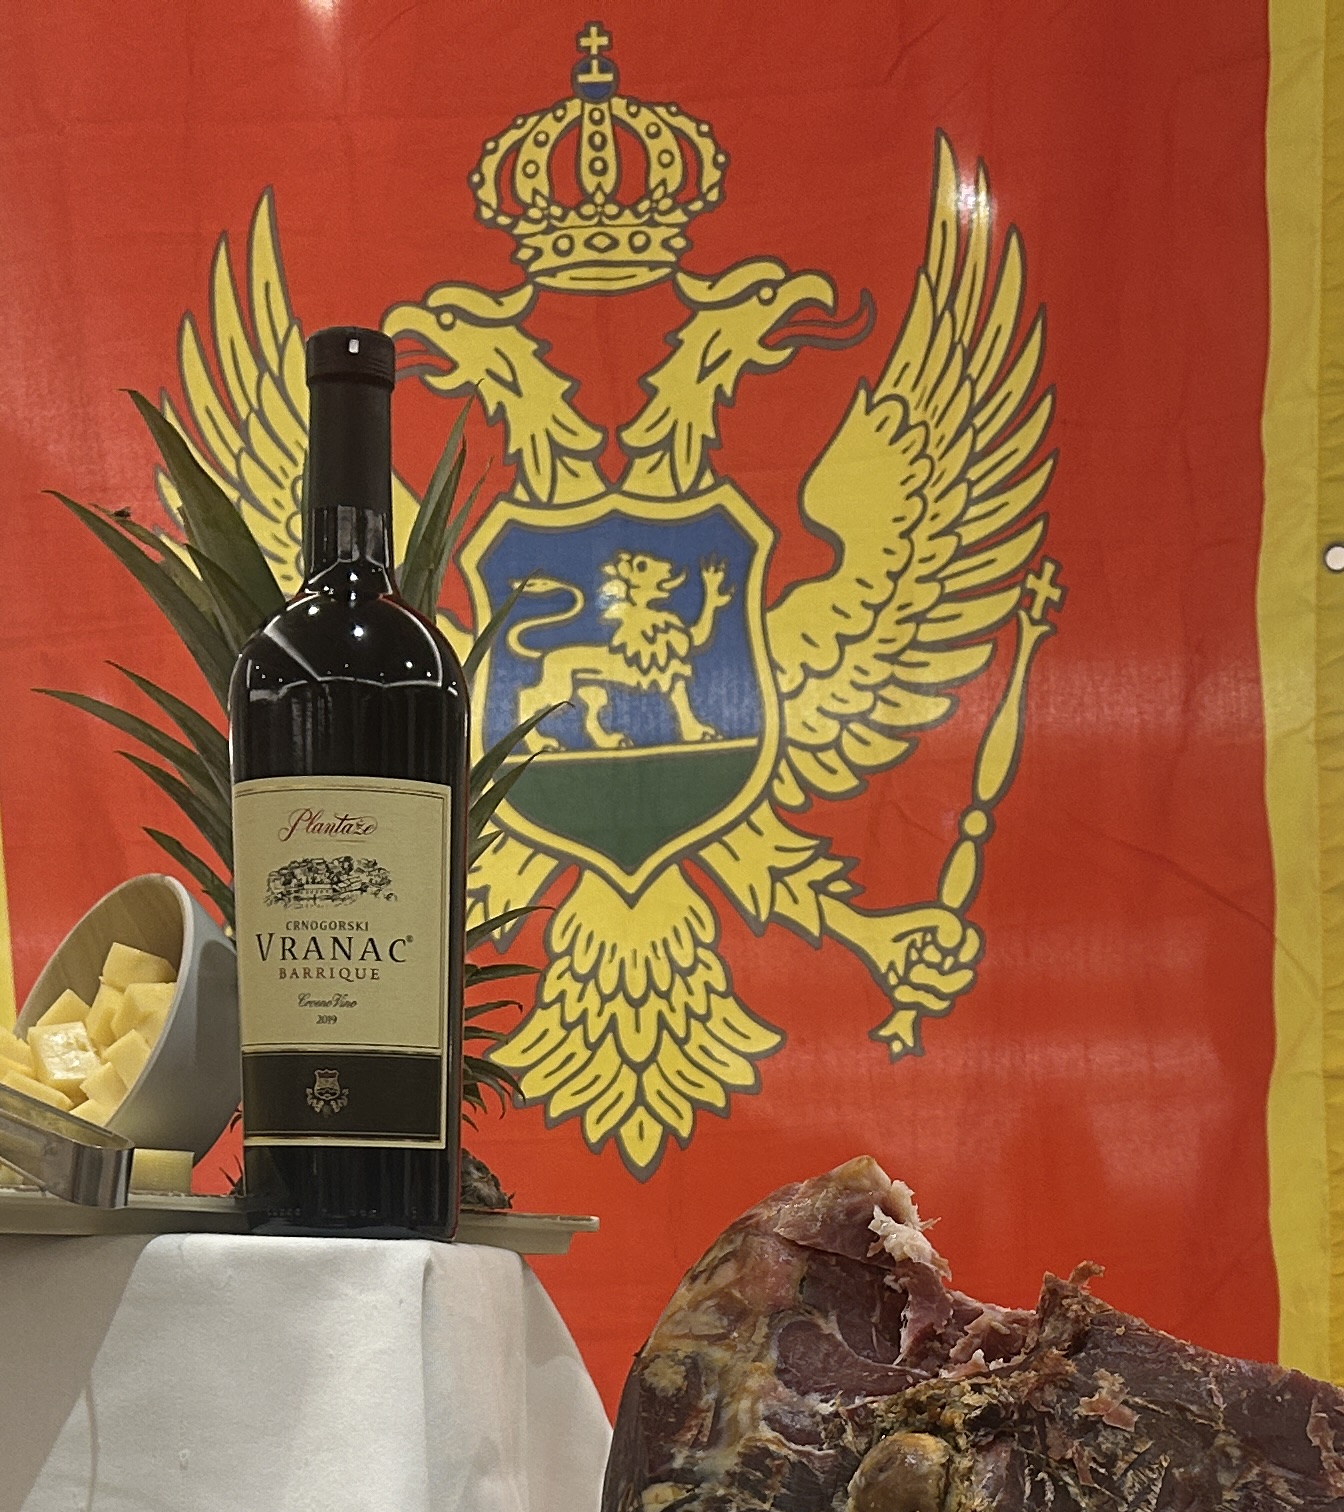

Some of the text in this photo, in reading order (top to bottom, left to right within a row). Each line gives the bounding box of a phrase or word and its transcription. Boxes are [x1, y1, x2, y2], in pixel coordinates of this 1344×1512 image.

[278, 808, 377, 842] Plantaže
[286, 921, 368, 931] CRNOGORSKI
[279, 968, 379, 982] BARRIQUE
